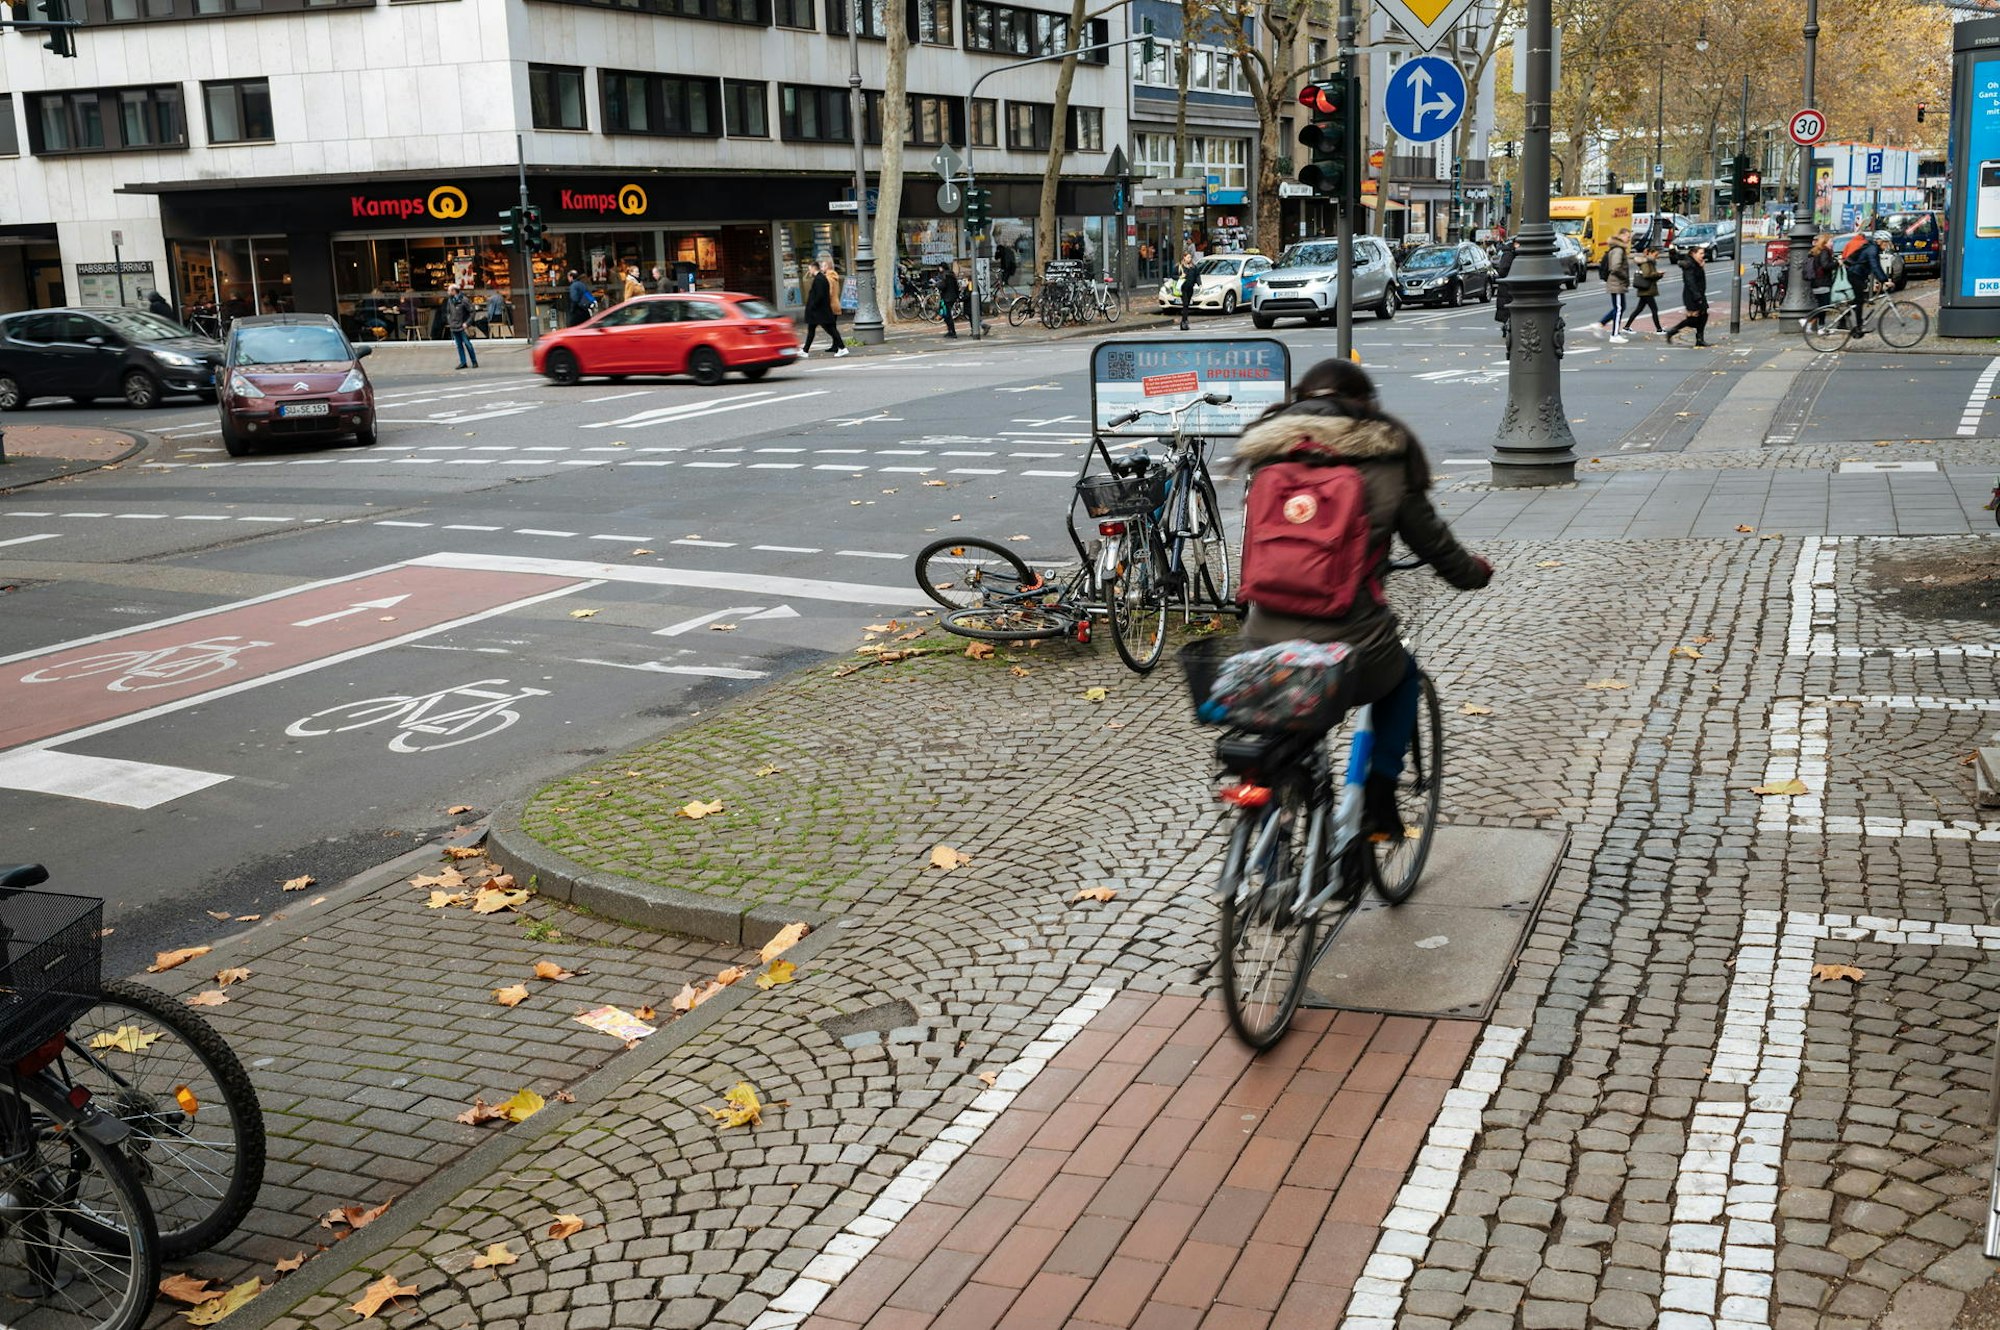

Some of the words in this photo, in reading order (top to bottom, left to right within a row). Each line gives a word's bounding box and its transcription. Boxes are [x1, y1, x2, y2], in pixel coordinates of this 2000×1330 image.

[1987, 81, 1999, 89] Oh
[1978, 91, 1998, 99] Ganz
[1796, 118, 1818, 136] 30
[561, 190, 617, 214] Kamps
[351, 196, 424, 220] Kamps
[1979, 282, 1999, 290] DKB
[1139, 349, 1270, 368] WESTGATE
[1207, 368, 1270, 379] APOTHEKE
[313, 404, 327, 412] 151
